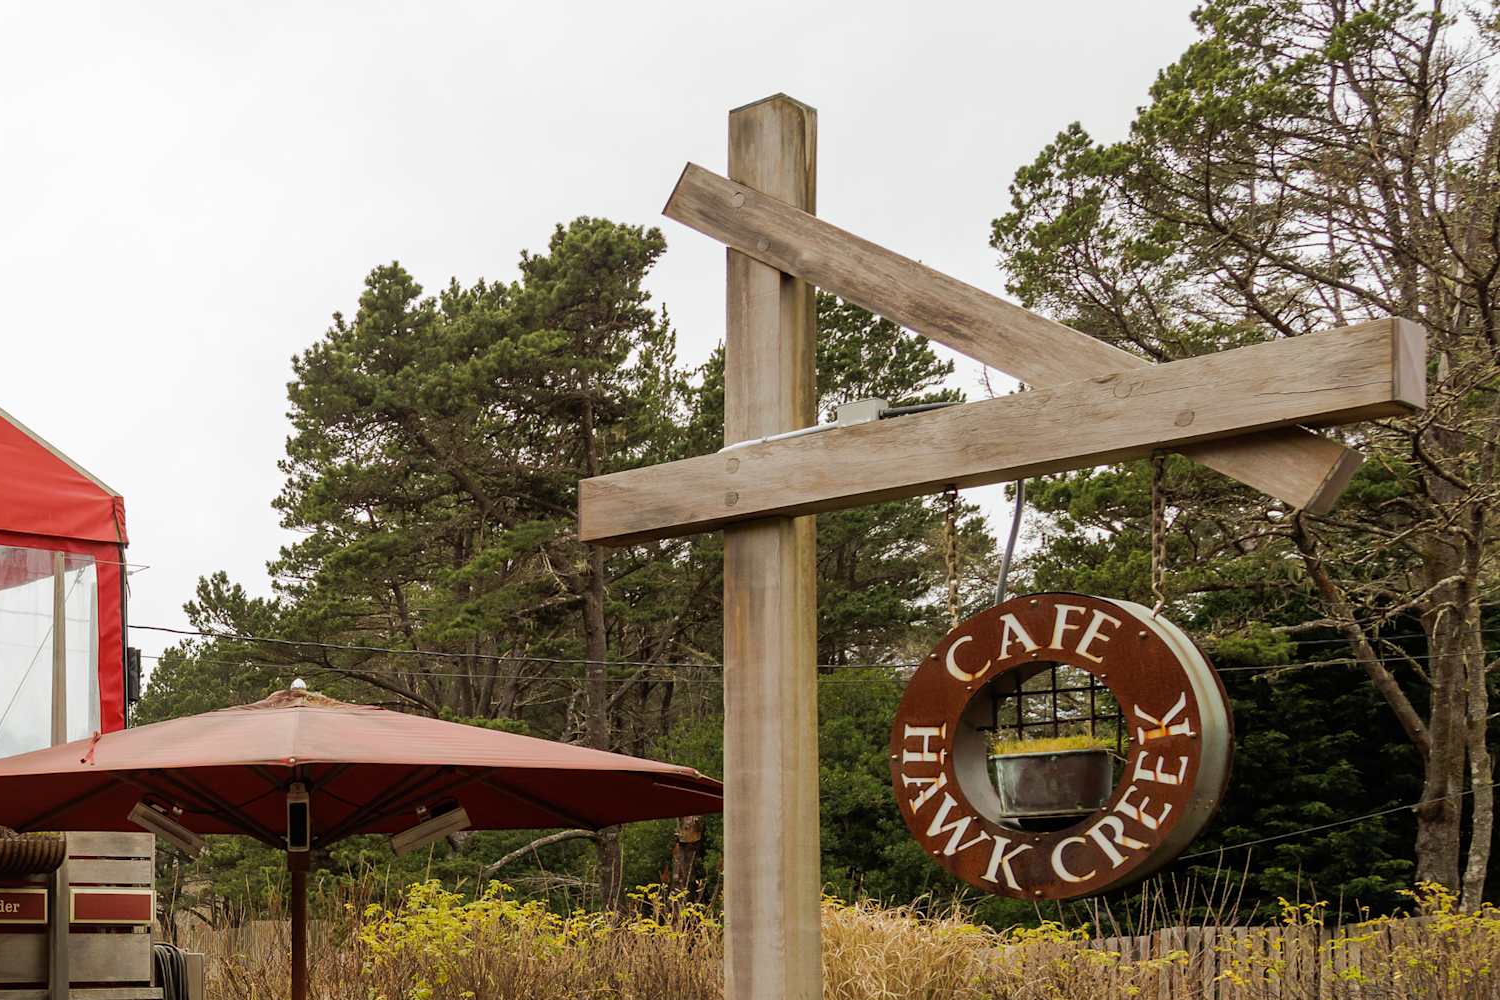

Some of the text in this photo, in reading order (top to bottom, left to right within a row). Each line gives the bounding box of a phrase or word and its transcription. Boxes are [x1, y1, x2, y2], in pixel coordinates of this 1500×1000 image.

[945, 603, 1122, 682] CAFE
[901, 691, 1192, 892] HAWK CREEK
